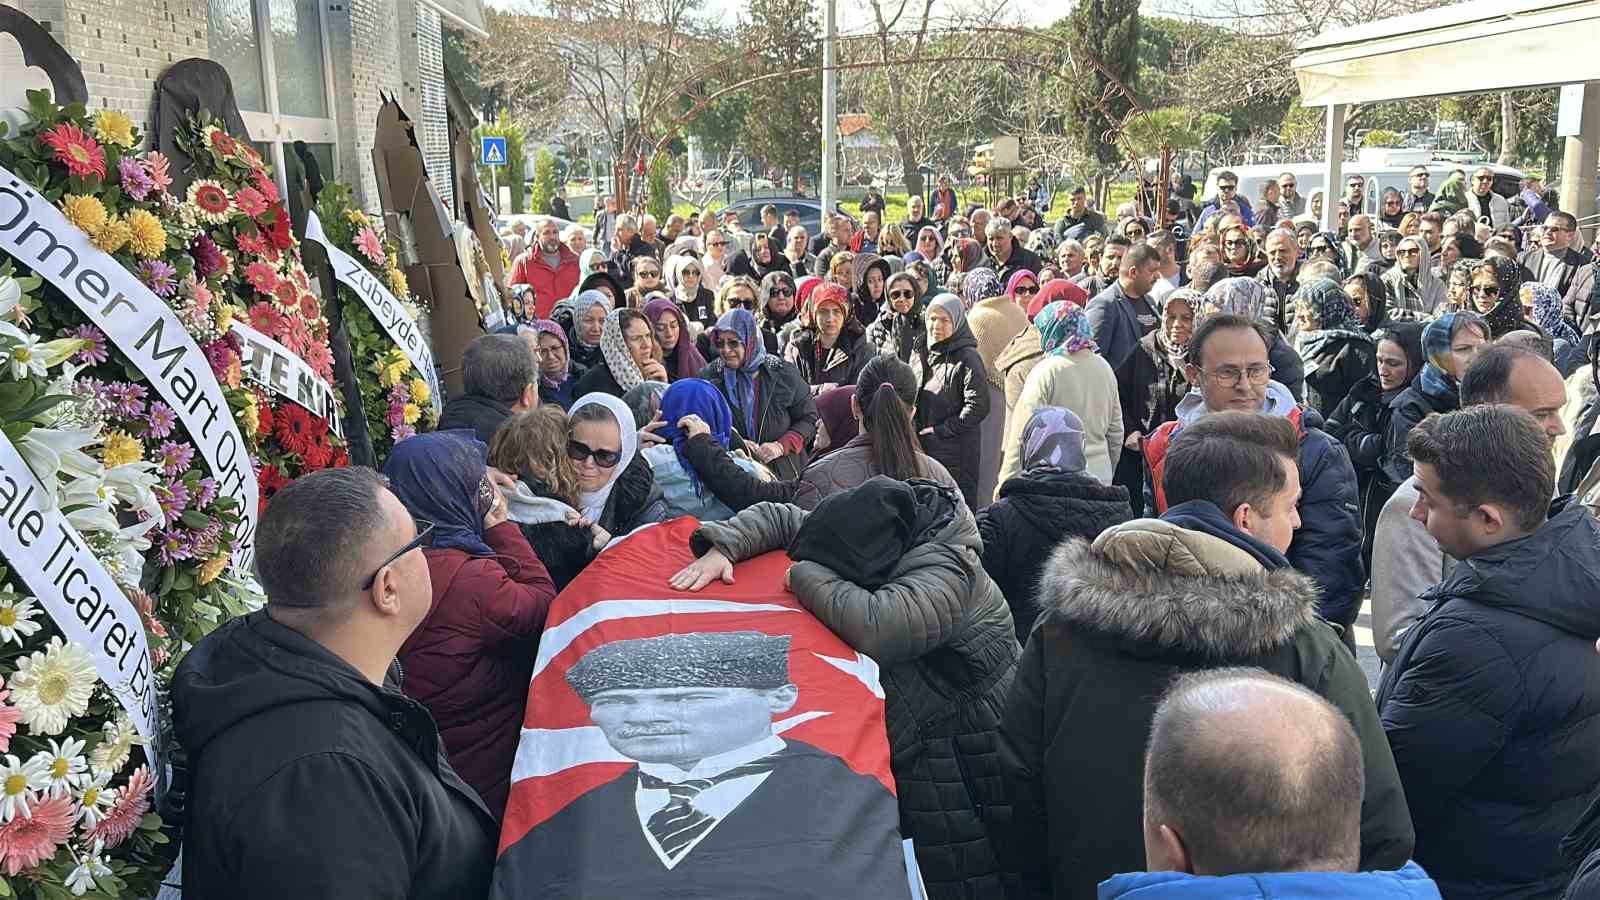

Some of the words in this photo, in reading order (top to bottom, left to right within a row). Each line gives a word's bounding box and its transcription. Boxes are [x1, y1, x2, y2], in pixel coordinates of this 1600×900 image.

[0, 180, 139, 318] Ömer
[134, 316, 219, 440] Mart
[231, 328, 290, 395] TE
[344, 262, 419, 350] Zübeyde
[0, 465, 44, 547] ale
[43, 523, 137, 671] Ticaret
